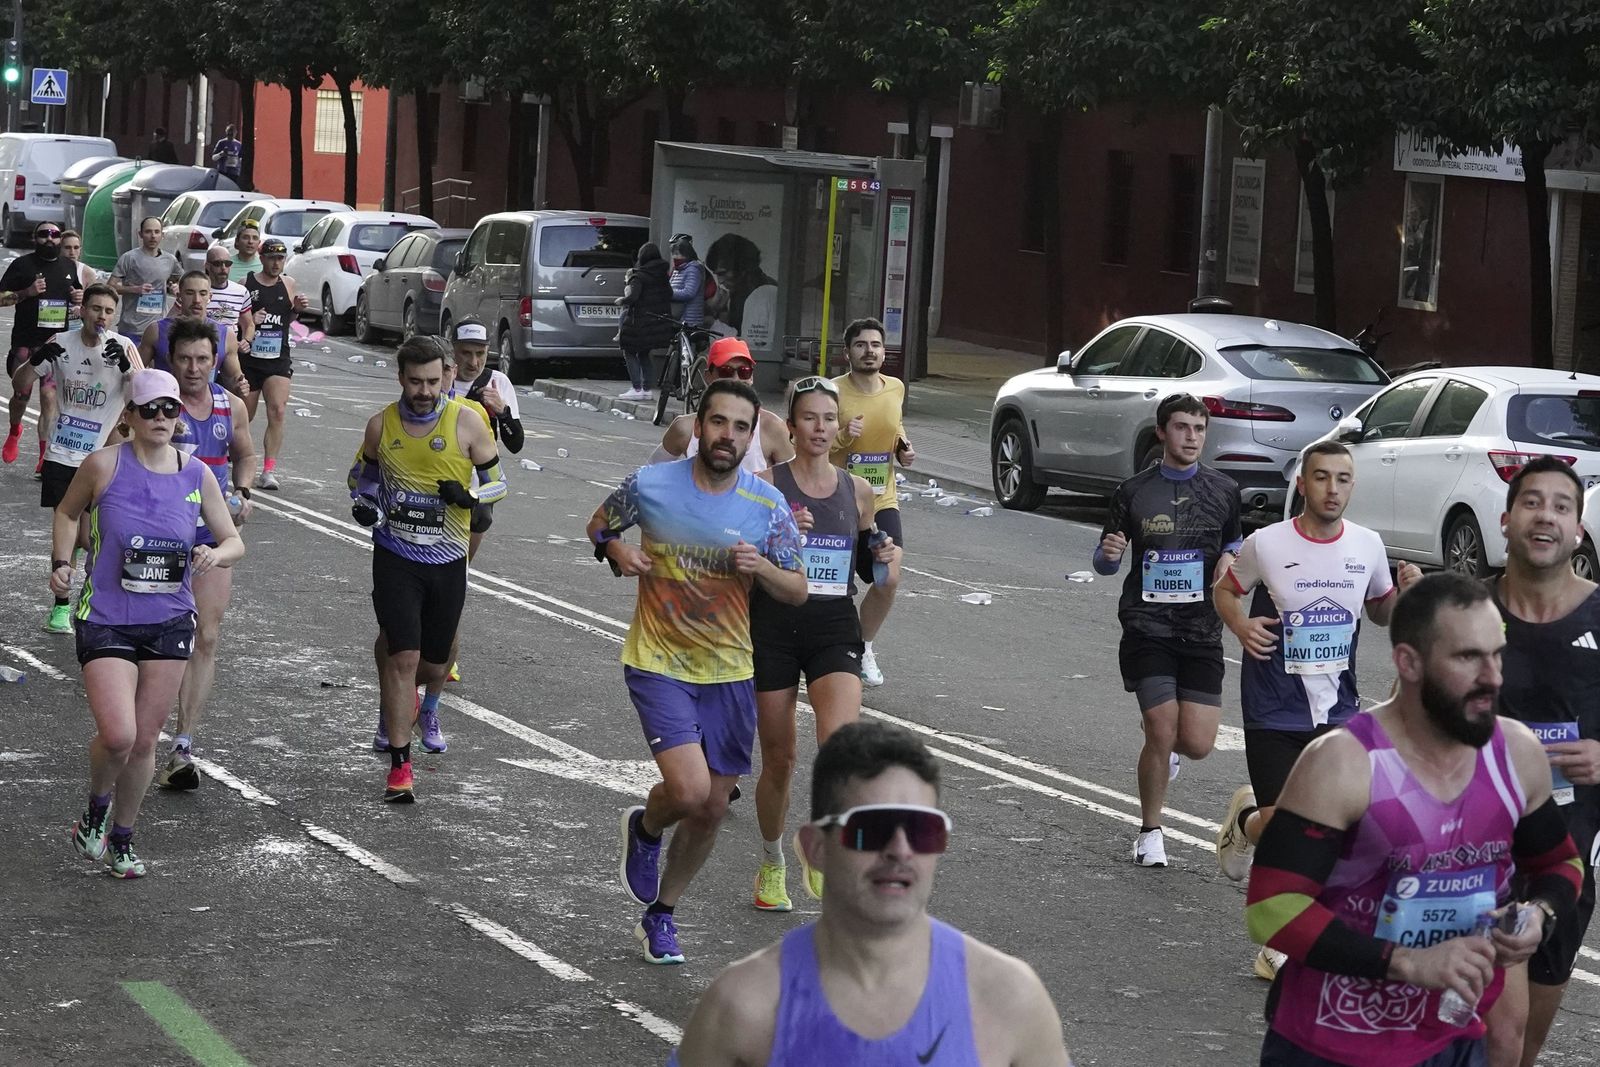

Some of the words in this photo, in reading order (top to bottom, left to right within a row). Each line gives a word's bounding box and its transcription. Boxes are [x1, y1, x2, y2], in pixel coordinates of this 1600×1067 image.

[838, 181, 848, 189] C2
[851, 181, 857, 189] 5
[861, 181, 868, 189] 6
[870, 182, 880, 190] 43
[581, 306, 603, 315] 5865
[56, 435, 82, 449] MARIO
[83, 442, 94, 452] 02
[409, 495, 440, 505] ZURICH
[407, 510, 425, 520] 4629
[416, 525, 443, 535] ROVIRA
[147, 540, 183, 549] ZURICH
[811, 537, 847, 548] ZURICH
[146, 556, 165, 565] 5024
[810, 554, 830, 564] 6318
[1345, 563, 1366, 571] Sevilla
[139, 567, 170, 580] JANE
[807, 567, 838, 581] LIZEE
[1163, 569, 1182, 577] 9492
[1154, 579, 1192, 590] RUBEN
[1296, 579, 1355, 590] mediolanum
[1308, 613, 1347, 624] ZURICH
[1310, 633, 1330, 643] 8223
[1285, 646, 1312, 660] JAVI
[1315, 643, 1351, 659] COTÁN
[1532, 728, 1567, 740] RICH
[1425, 873, 1484, 893] ZURICH
[1422, 909, 1457, 922] 5572
